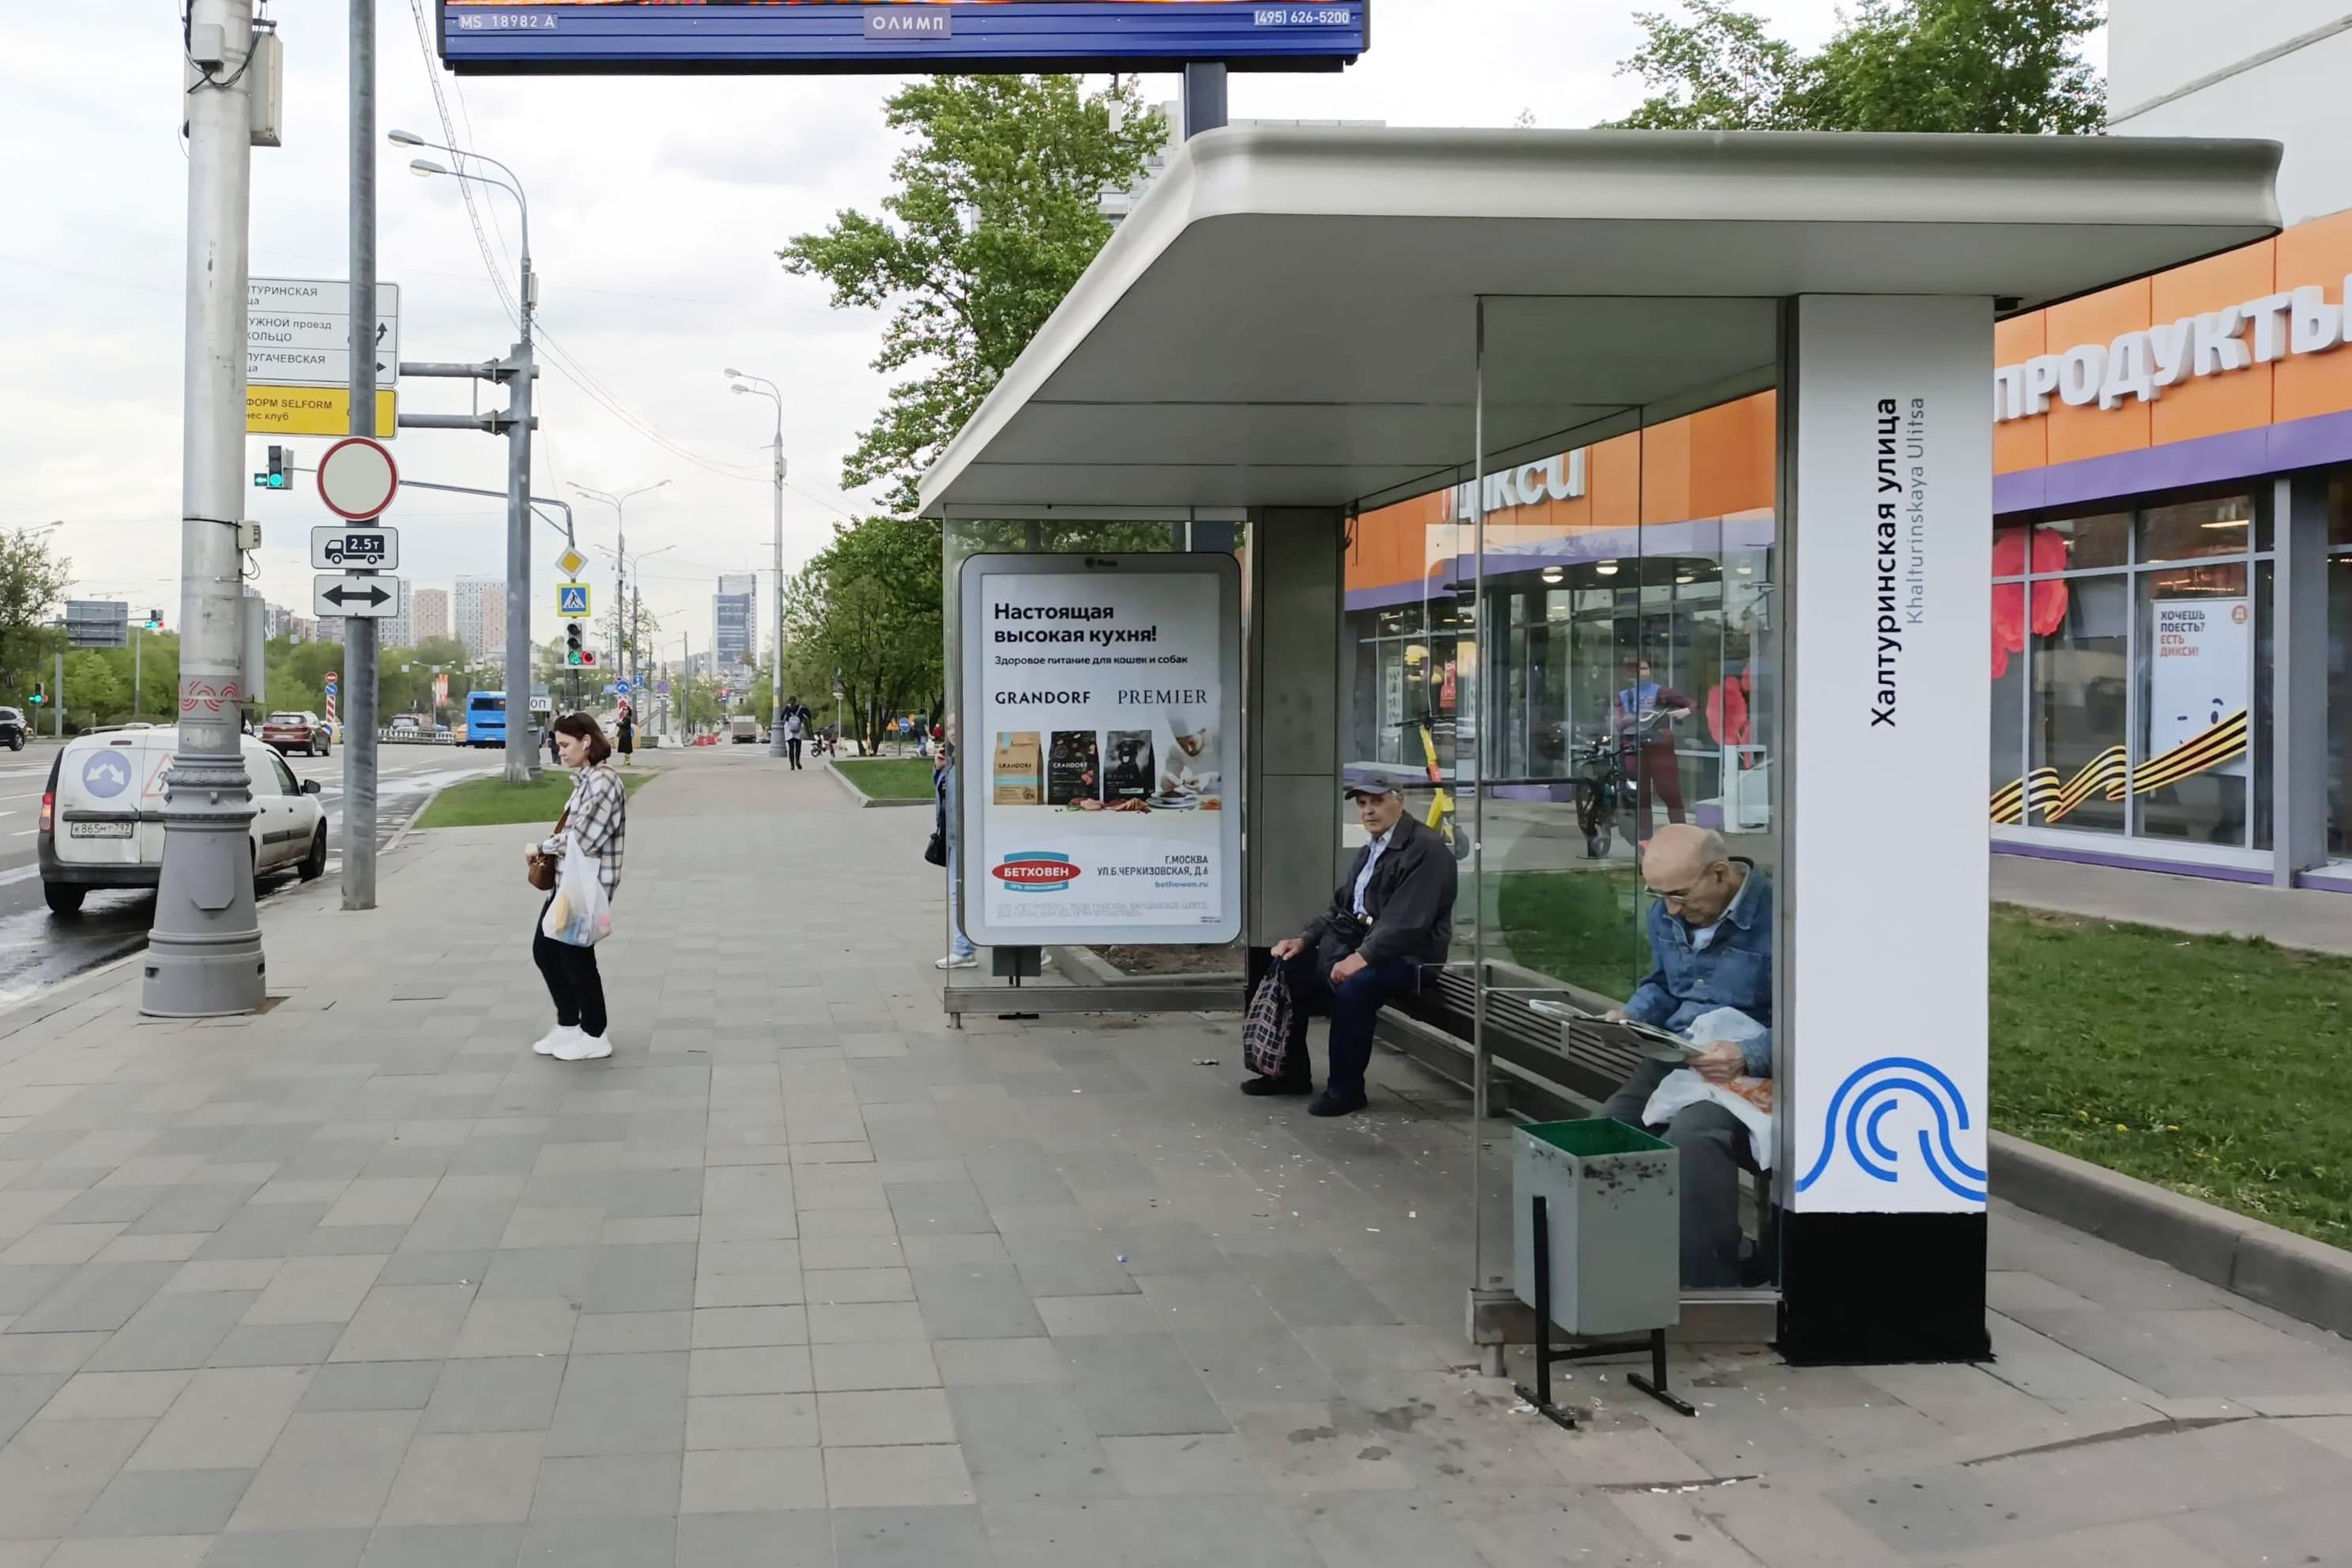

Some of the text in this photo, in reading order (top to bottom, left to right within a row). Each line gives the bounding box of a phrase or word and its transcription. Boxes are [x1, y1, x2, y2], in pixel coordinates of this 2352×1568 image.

[461, 16, 555, 28] MS 18982 A
[1255, 10, 1349, 24] (495) 626-5200
[873, 17, 943, 30] ОЛИМП
[248, 285, 318, 296] ТУРИНСКАЯ
[249, 317, 331, 330] УЖНОЙ проезд
[1994, 273, 2352, 423] ПРОДУКТЫ
[247, 398, 333, 409] ФОРМ SELFORM
[265, 412, 289, 422] клуб
[1906, 398, 1928, 624] Khalturinskaya Ulitsa
[1871, 398, 1902, 727] Халтуринская улица
[994, 603, 1114, 622] Настоящая
[2161, 611, 2206, 620] ХОЧЕШЬ
[2161, 623, 2205, 632] ПОЕСТЬ?
[994, 625, 1157, 646] высокая кухня!
[2161, 635, 2184, 644] ЕСТЬ
[2160, 646, 2199, 658] ДИКСИ!
[994, 656, 1046, 665] Здоровое
[1047, 656, 1091, 665] питание
[1092, 657, 1112, 665] для
[1158, 654, 1188, 664] собак
[995, 692, 1091, 704] GRANDORF
[1118, 689, 1208, 704] PREMIER
[530, 699, 545, 708] ОП
[1165, 855, 1208, 865] Г.МОСКВА
[1004, 867, 1069, 876] БЕТХОВЕН
